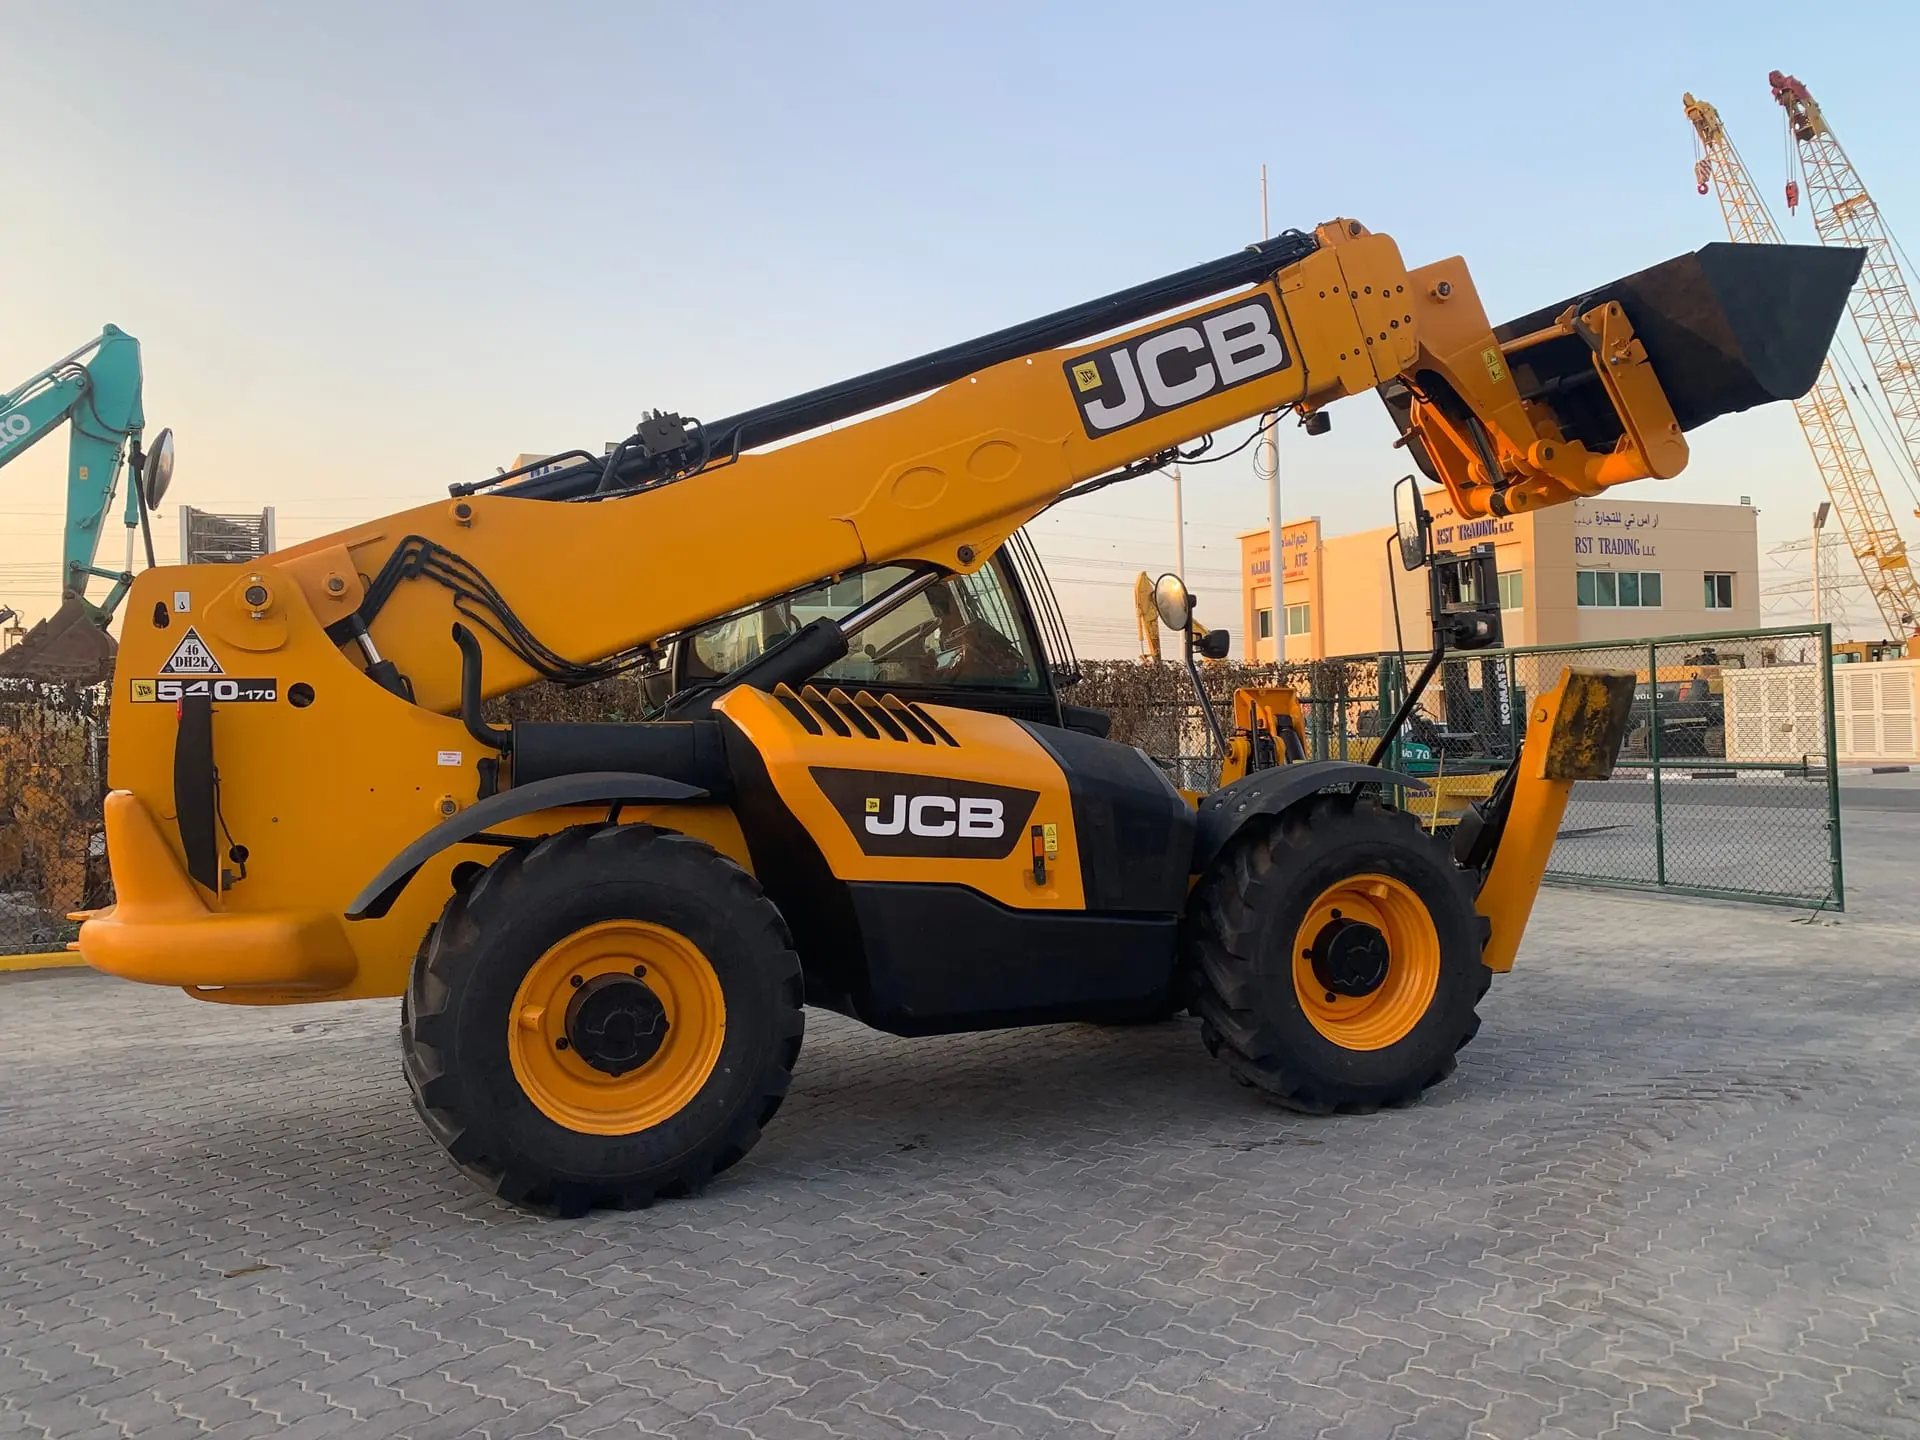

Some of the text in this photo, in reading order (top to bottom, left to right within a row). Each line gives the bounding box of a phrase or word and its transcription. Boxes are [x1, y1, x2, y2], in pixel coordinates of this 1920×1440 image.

[1084, 303, 1283, 430] JCB
[1080, 368, 1096, 385] JCB
[1595, 511, 1621, 526] للتجارة
[1437, 526, 1454, 545] RST
[1457, 518, 1498, 541] TRADING
[1575, 536, 1594, 554] RST
[1598, 537, 1641, 556] TRADING
[185, 644, 199, 656] 46
[175, 656, 210, 668] DH2K
[135, 683, 153, 698] JCB
[1634, 692, 1664, 700] VOLO
[1416, 749, 1430, 760] 70
[865, 795, 1005, 838] JCB
